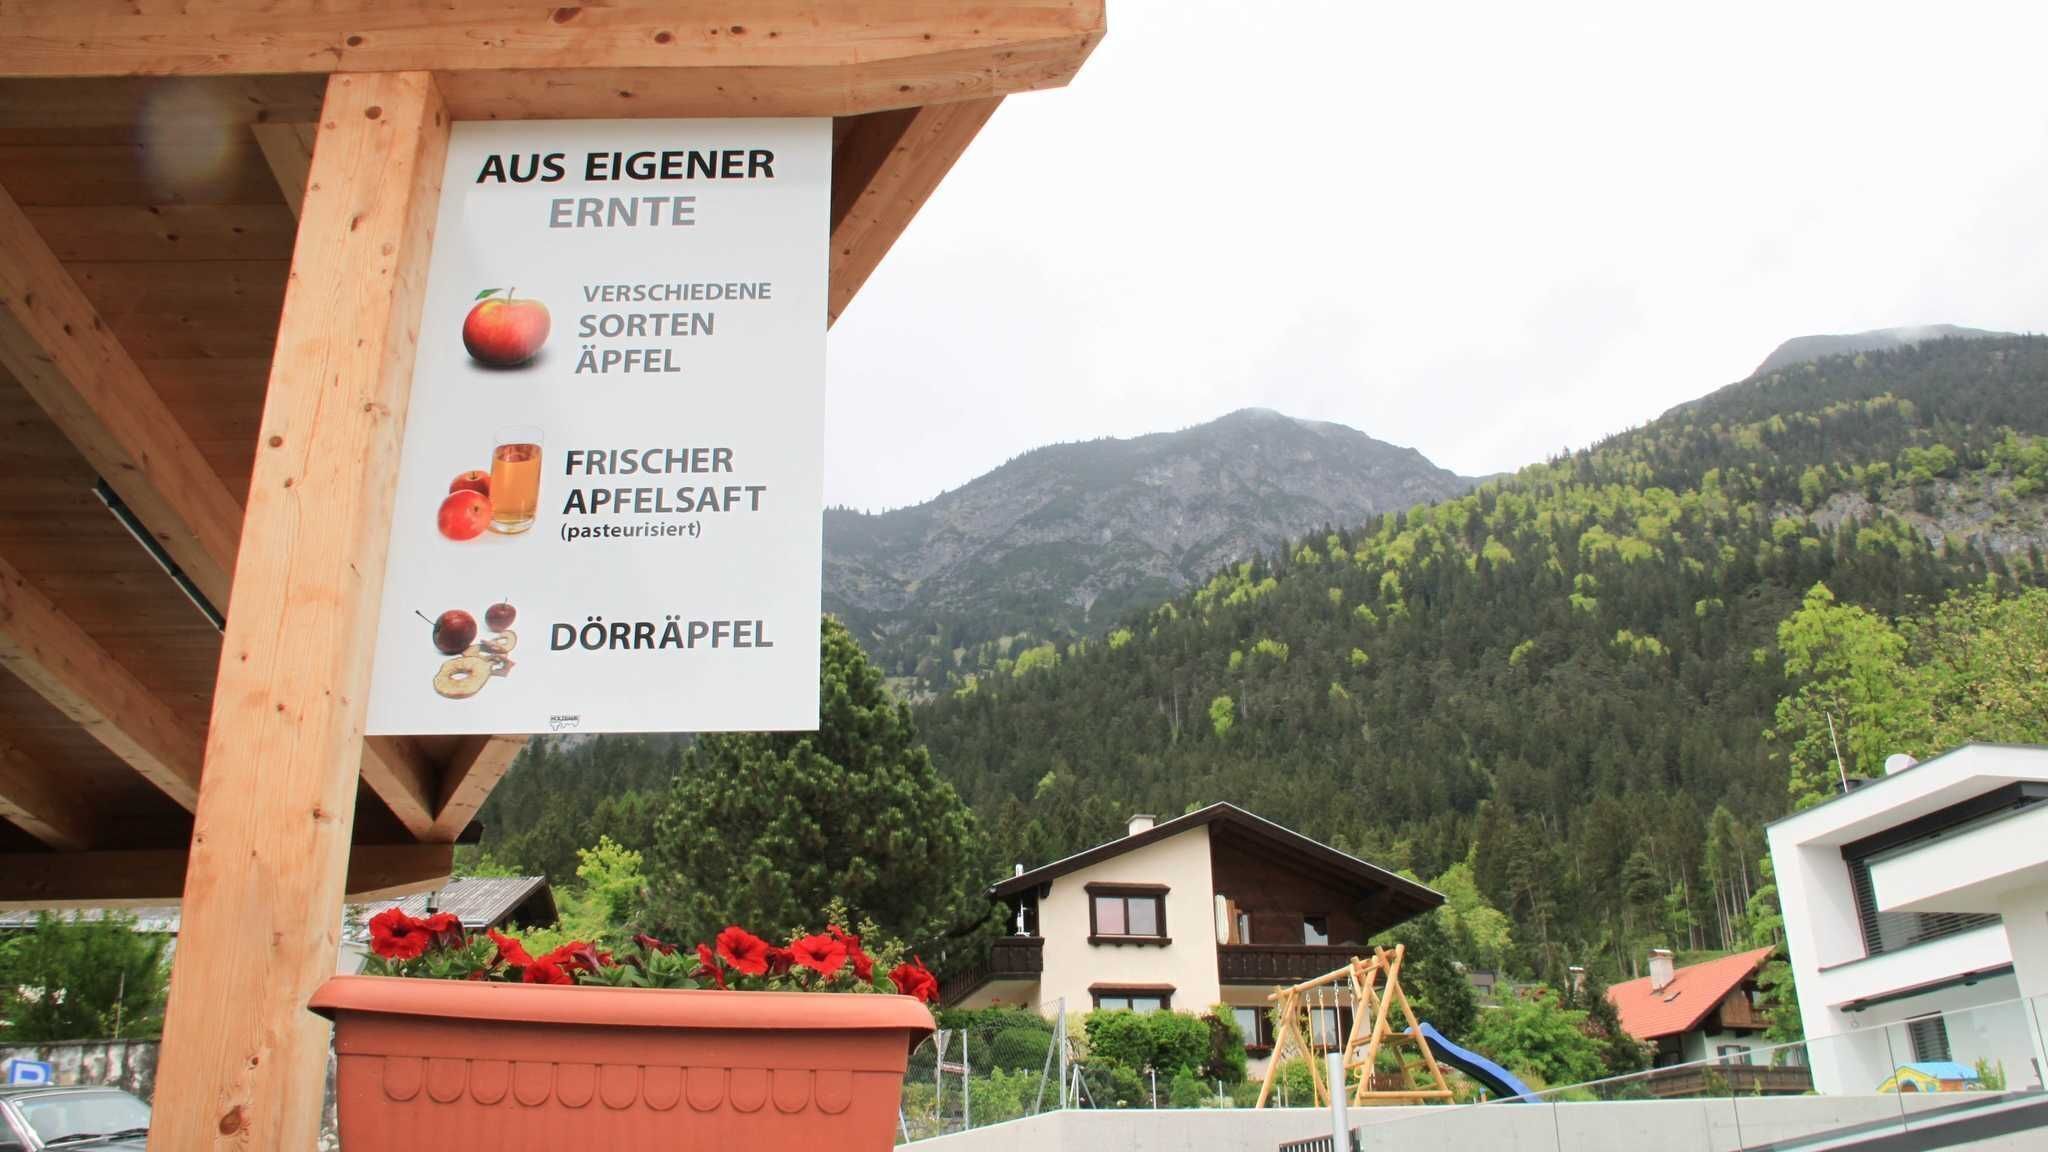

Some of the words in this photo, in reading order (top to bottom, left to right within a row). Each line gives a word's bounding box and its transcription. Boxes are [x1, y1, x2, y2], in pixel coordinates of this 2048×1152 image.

[476, 153, 565, 183] AUS
[585, 150, 773, 181] EIGENER
[549, 196, 696, 228] ERNTE
[584, 283, 771, 302] VERSCHIEDENE
[579, 312, 714, 338] SORTEN
[575, 344, 680, 374] ÄPFEL
[566, 448, 732, 475] FRISCHER
[563, 486, 766, 514] APFELSAFT
[561, 521, 700, 542] (pasteurisiert)
[551, 615, 773, 650] DÖRRÄPFEL
